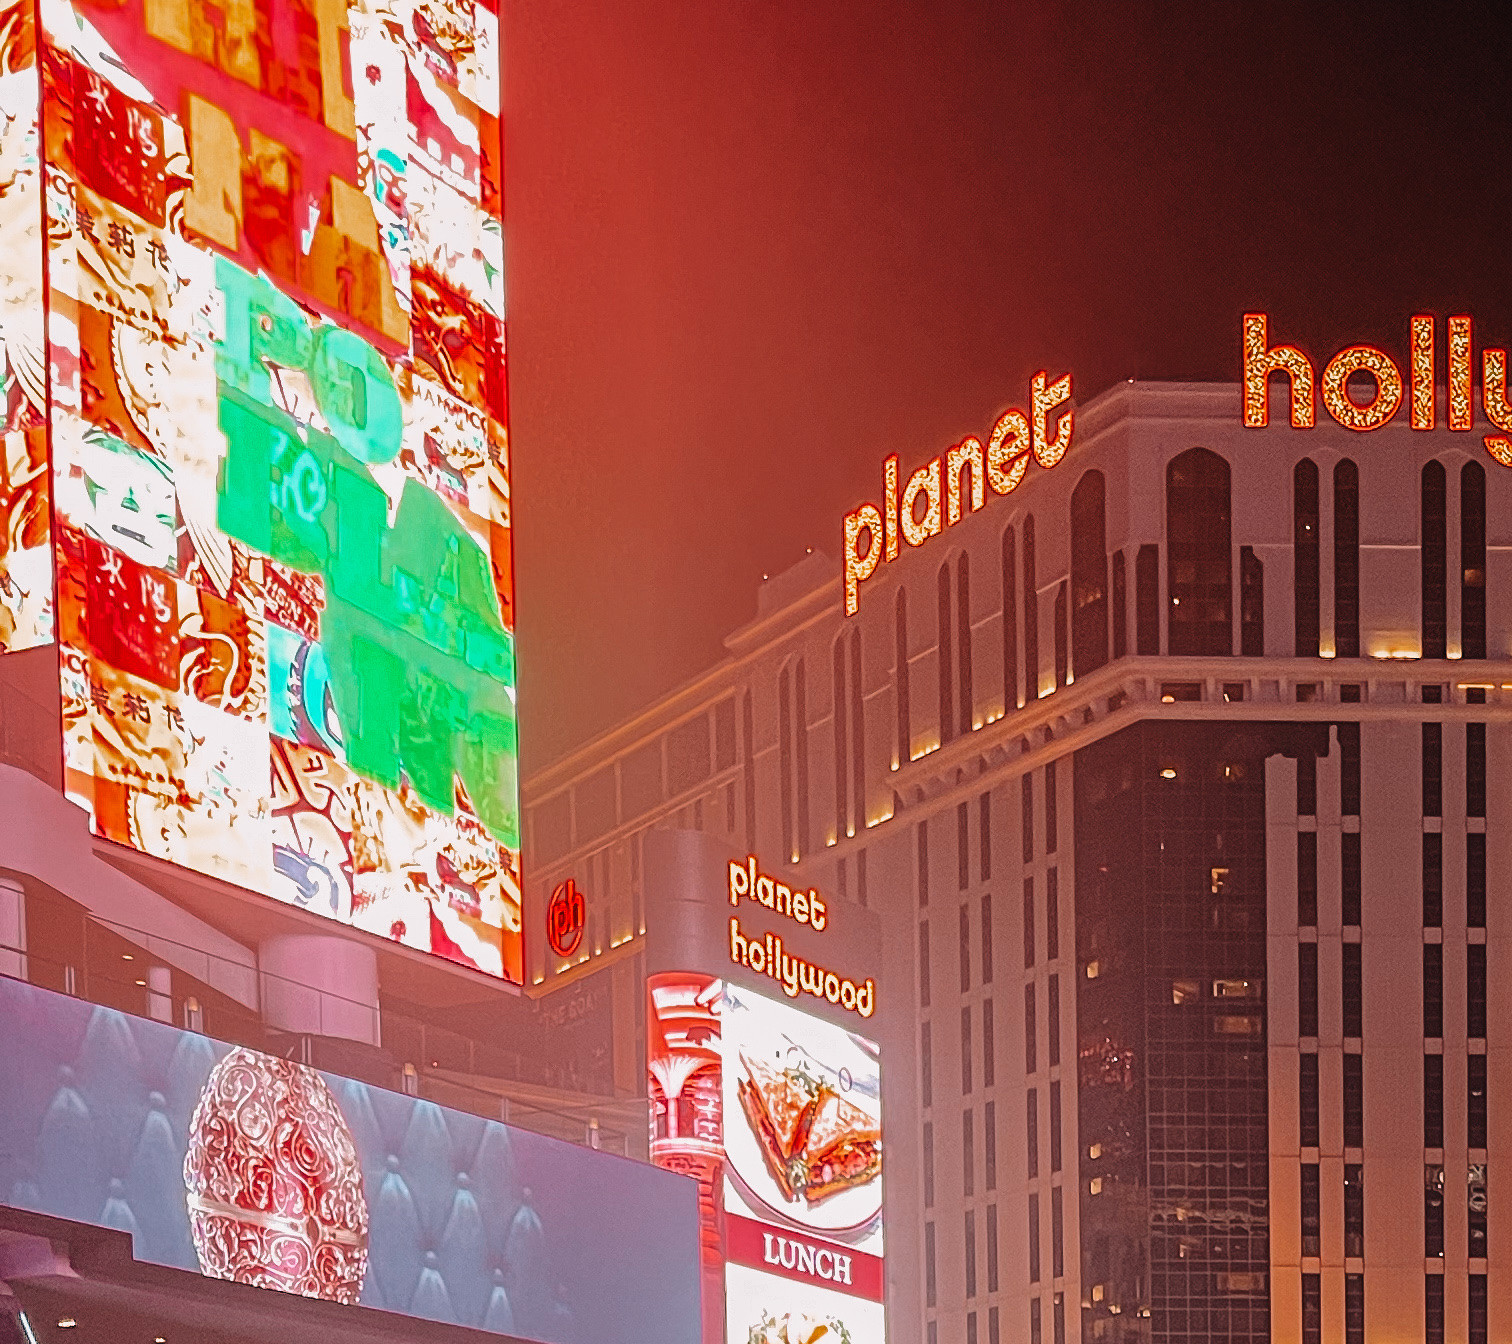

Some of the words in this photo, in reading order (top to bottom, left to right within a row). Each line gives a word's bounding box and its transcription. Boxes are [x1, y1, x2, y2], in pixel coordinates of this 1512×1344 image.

[843, 369, 1074, 617] planet
[729, 854, 827, 932] planet
[730, 917, 875, 1018] hollywood
[763, 1232, 853, 1285] LUNCH
